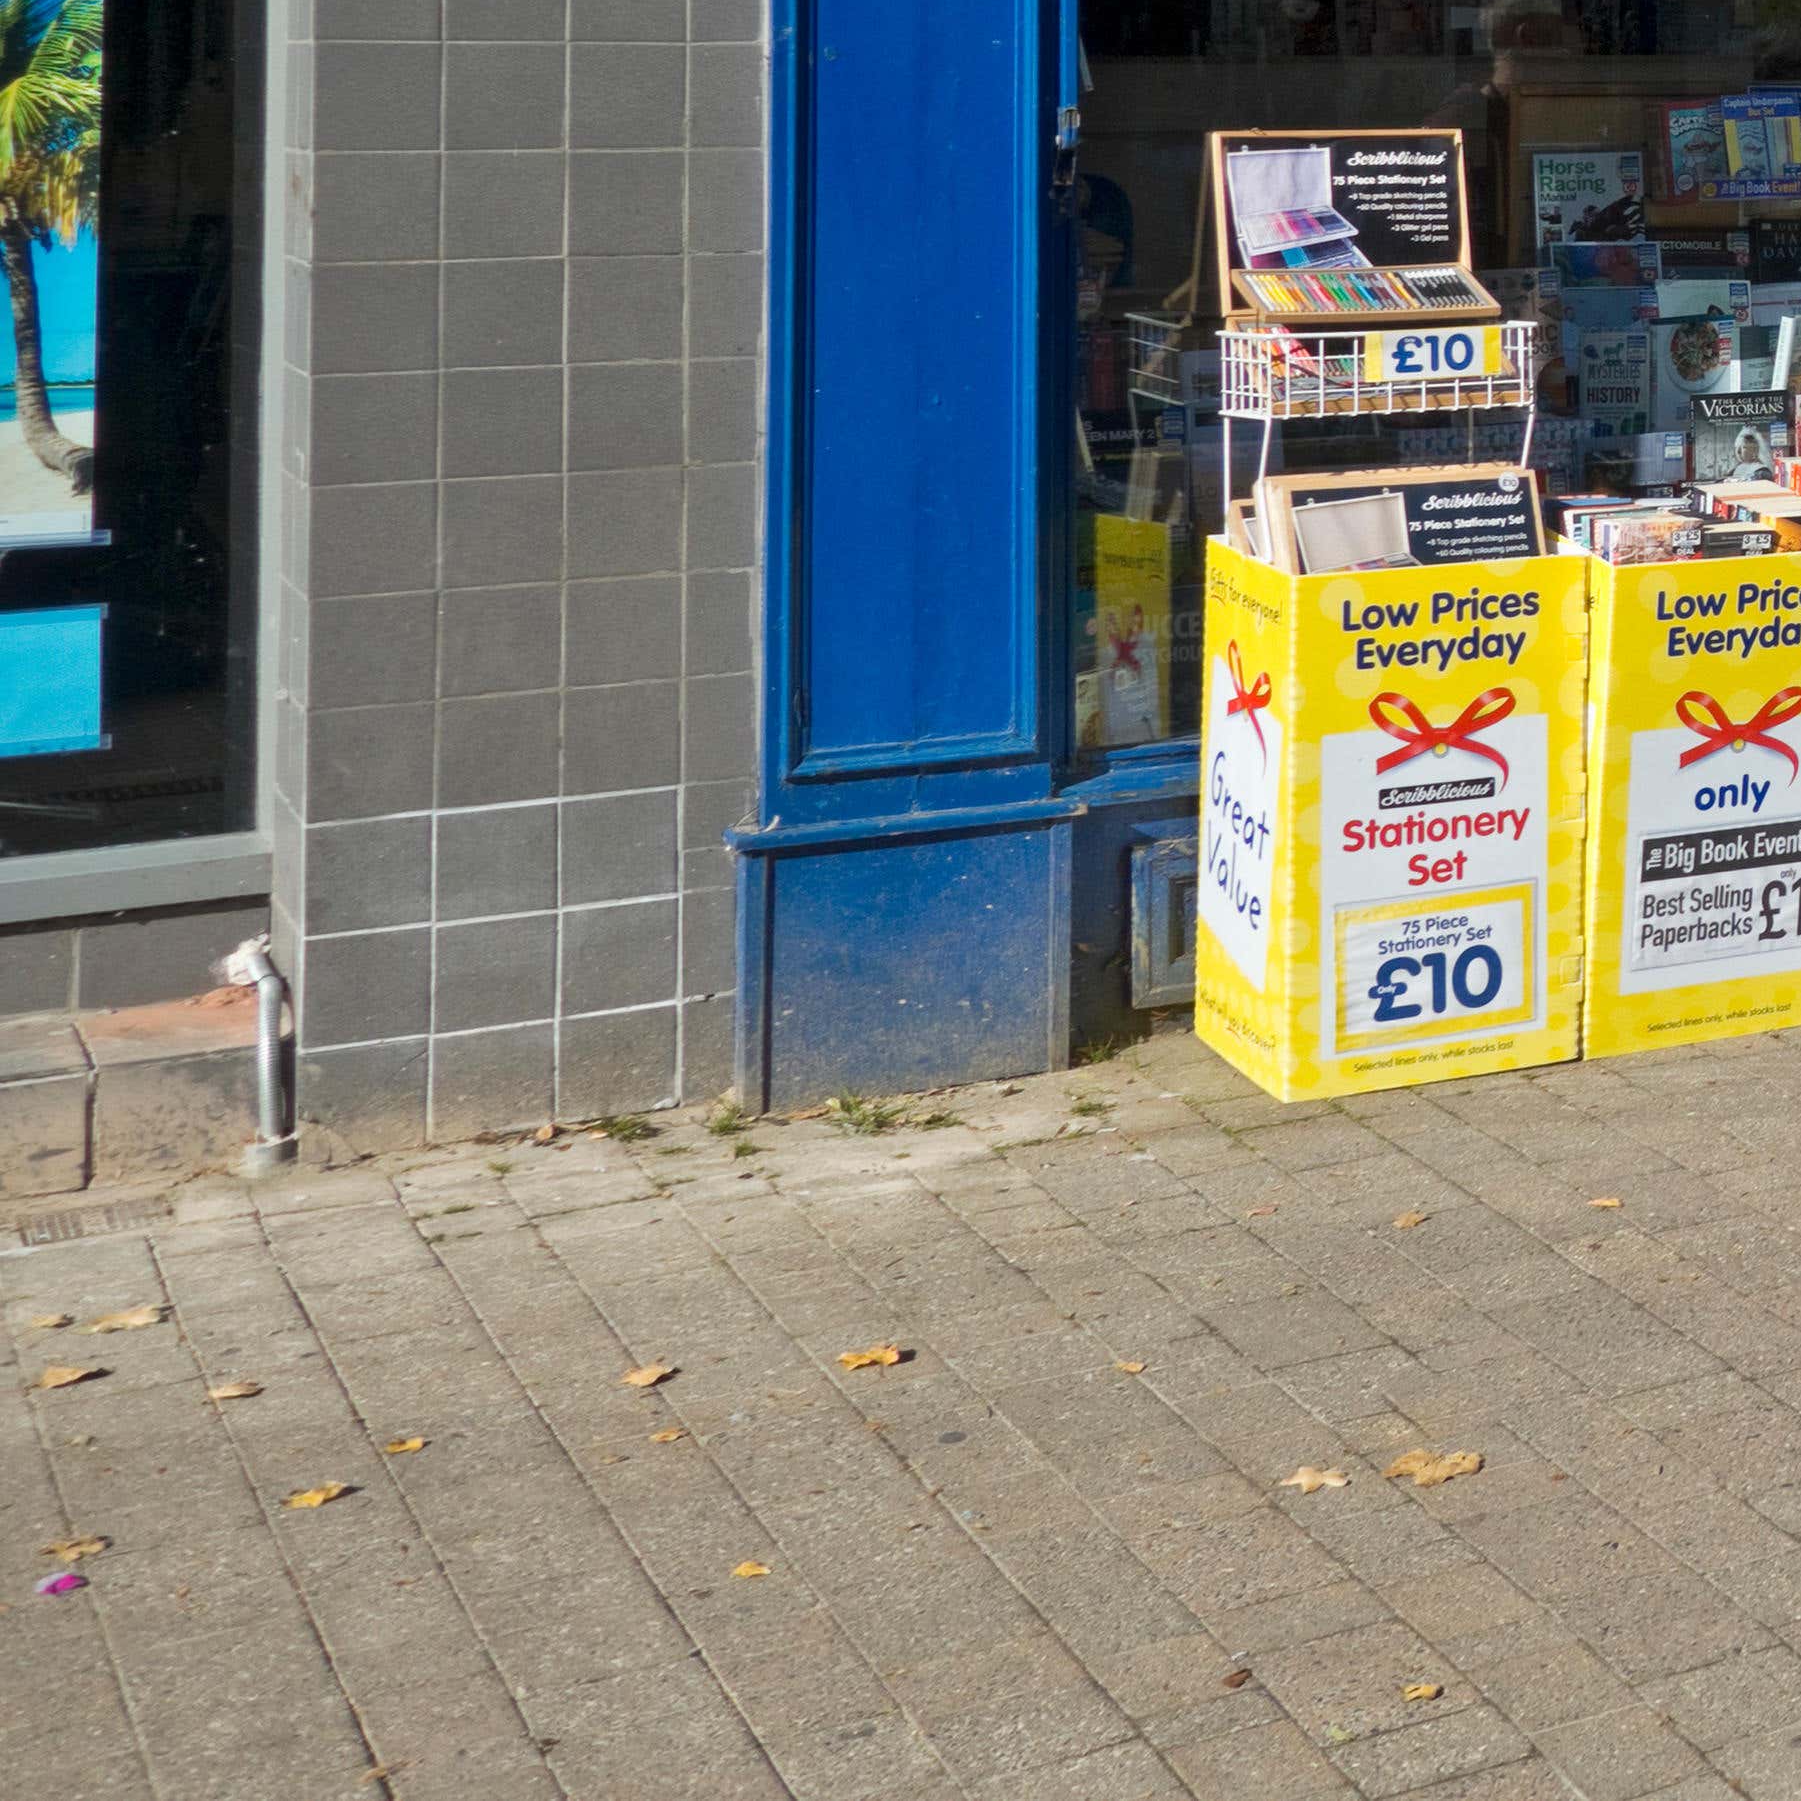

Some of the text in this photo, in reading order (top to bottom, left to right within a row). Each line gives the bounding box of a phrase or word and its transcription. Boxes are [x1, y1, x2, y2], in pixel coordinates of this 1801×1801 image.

[1347, 151, 1447, 166] Scribblicious
[1538, 158, 1596, 175] Horse
[1333, 174, 1446, 186] 75 Piece Stationery Set
[1538, 175, 1606, 194] Racing
[1392, 332, 1474, 374] £10
[1587, 386, 1641, 404] HISTORY
[1422, 491, 1523, 510] Scribblicious
[1409, 514, 1526, 531] 75 Piece Stationery Set
[1656, 590, 1727, 622] Low
[1356, 626, 1526, 671] Everyday
[1206, 818, 1263, 931] Value
[1408, 851, 1467, 887] Set
[1641, 883, 1754, 920] Best Selling
[1401, 913, 1469, 935] 75 Piece
[1640, 912, 1754, 952] Paperbacks
[1368, 944, 1502, 1023] £10
